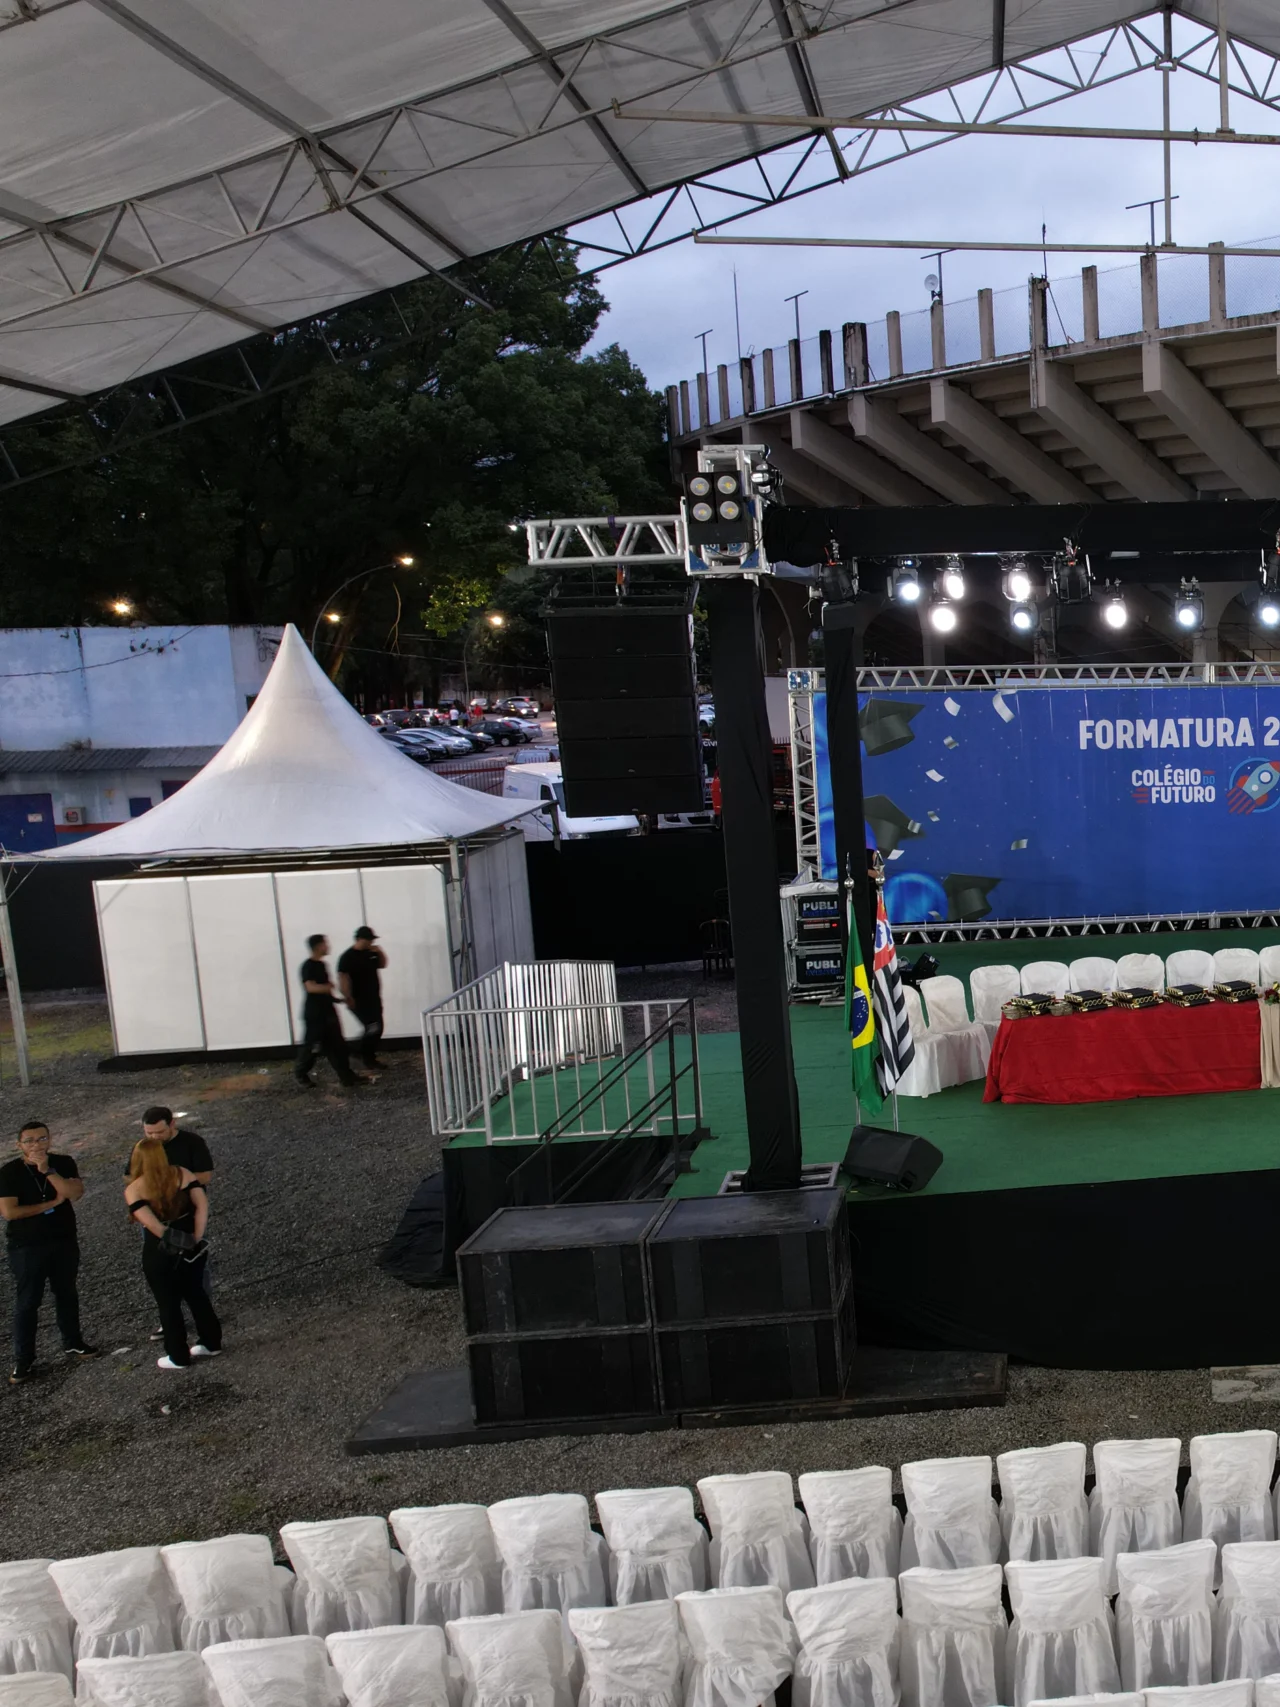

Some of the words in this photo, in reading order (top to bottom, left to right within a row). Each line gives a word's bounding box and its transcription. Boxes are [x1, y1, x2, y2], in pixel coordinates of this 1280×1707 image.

[1079, 717, 1255, 750] FORMATURA
[1131, 764, 1201, 787] COLÉGIO
[1203, 775, 1215, 785] DO
[1151, 785, 1216, 804] FUTURO
[803, 901, 837, 911] PUBLI
[806, 960, 840, 970] PUBLI
